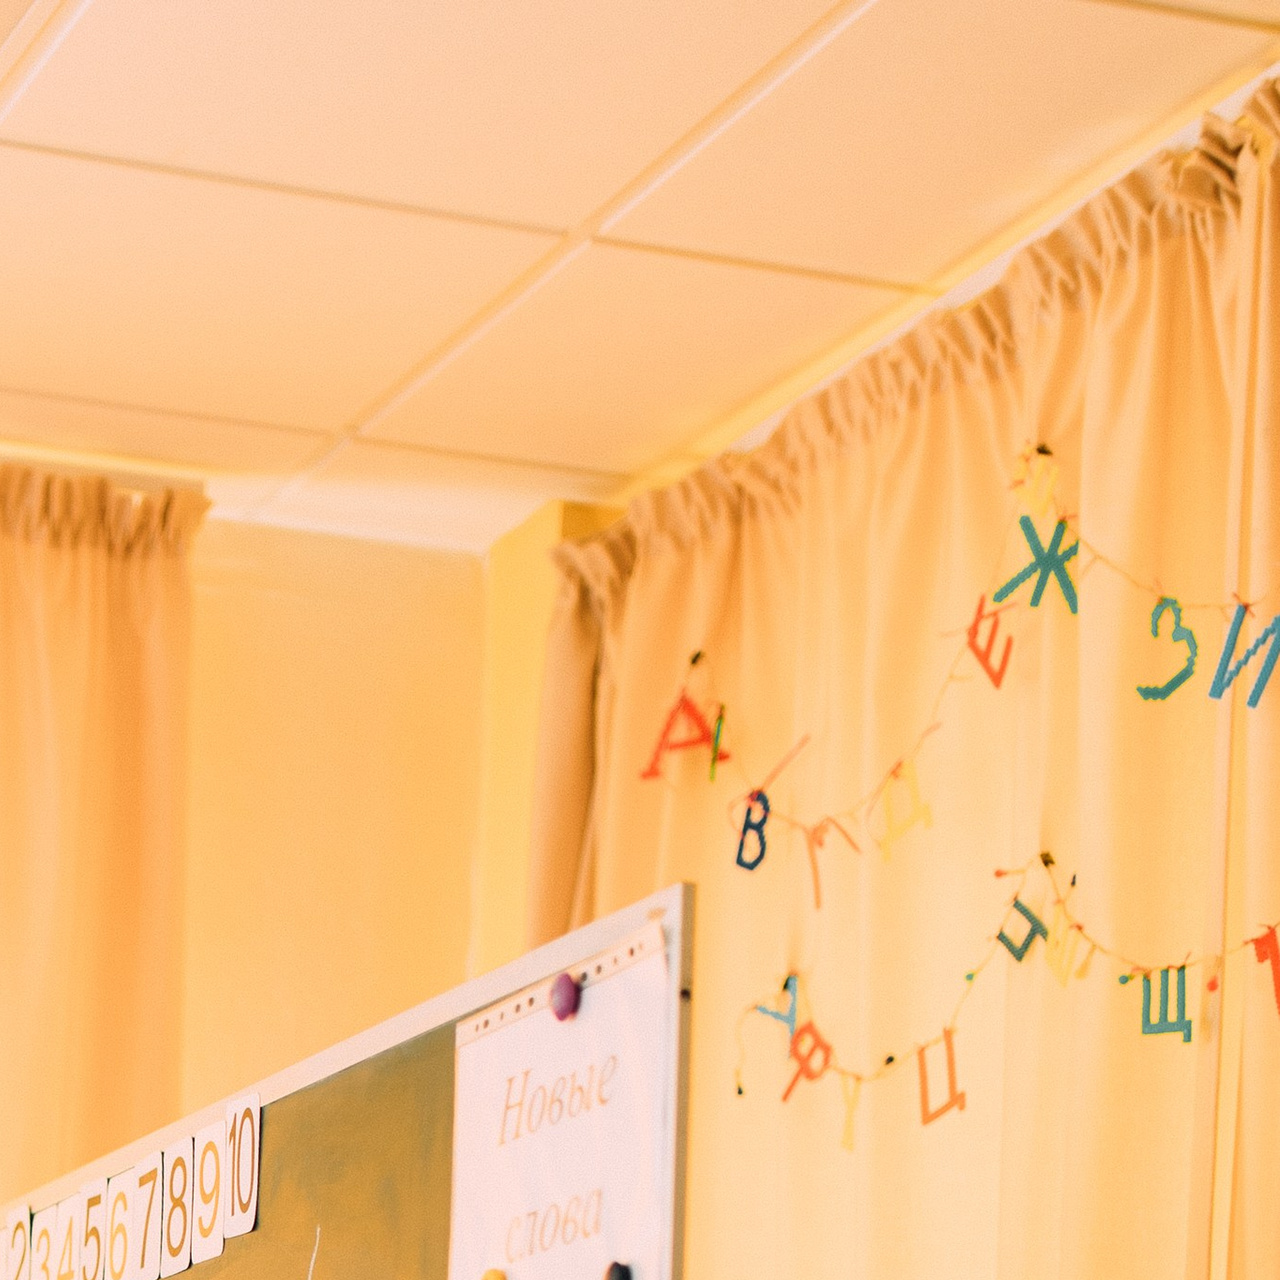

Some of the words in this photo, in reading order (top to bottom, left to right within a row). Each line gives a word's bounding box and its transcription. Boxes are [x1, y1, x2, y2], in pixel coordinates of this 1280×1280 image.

[993, 515, 1079, 615] Ж
[1207, 603, 1280, 709] И
[641, 686, 730, 780] А
[1141, 965, 1192, 1043] Щ
[497, 1055, 618, 1147] Новые
[138, 1167, 159, 1270] 7
[166, 1156, 188, 1258] 8
[198, 1140, 221, 1239] 9
[228, 1107, 256, 1218] 10
[505, 1187, 603, 1265] слова
